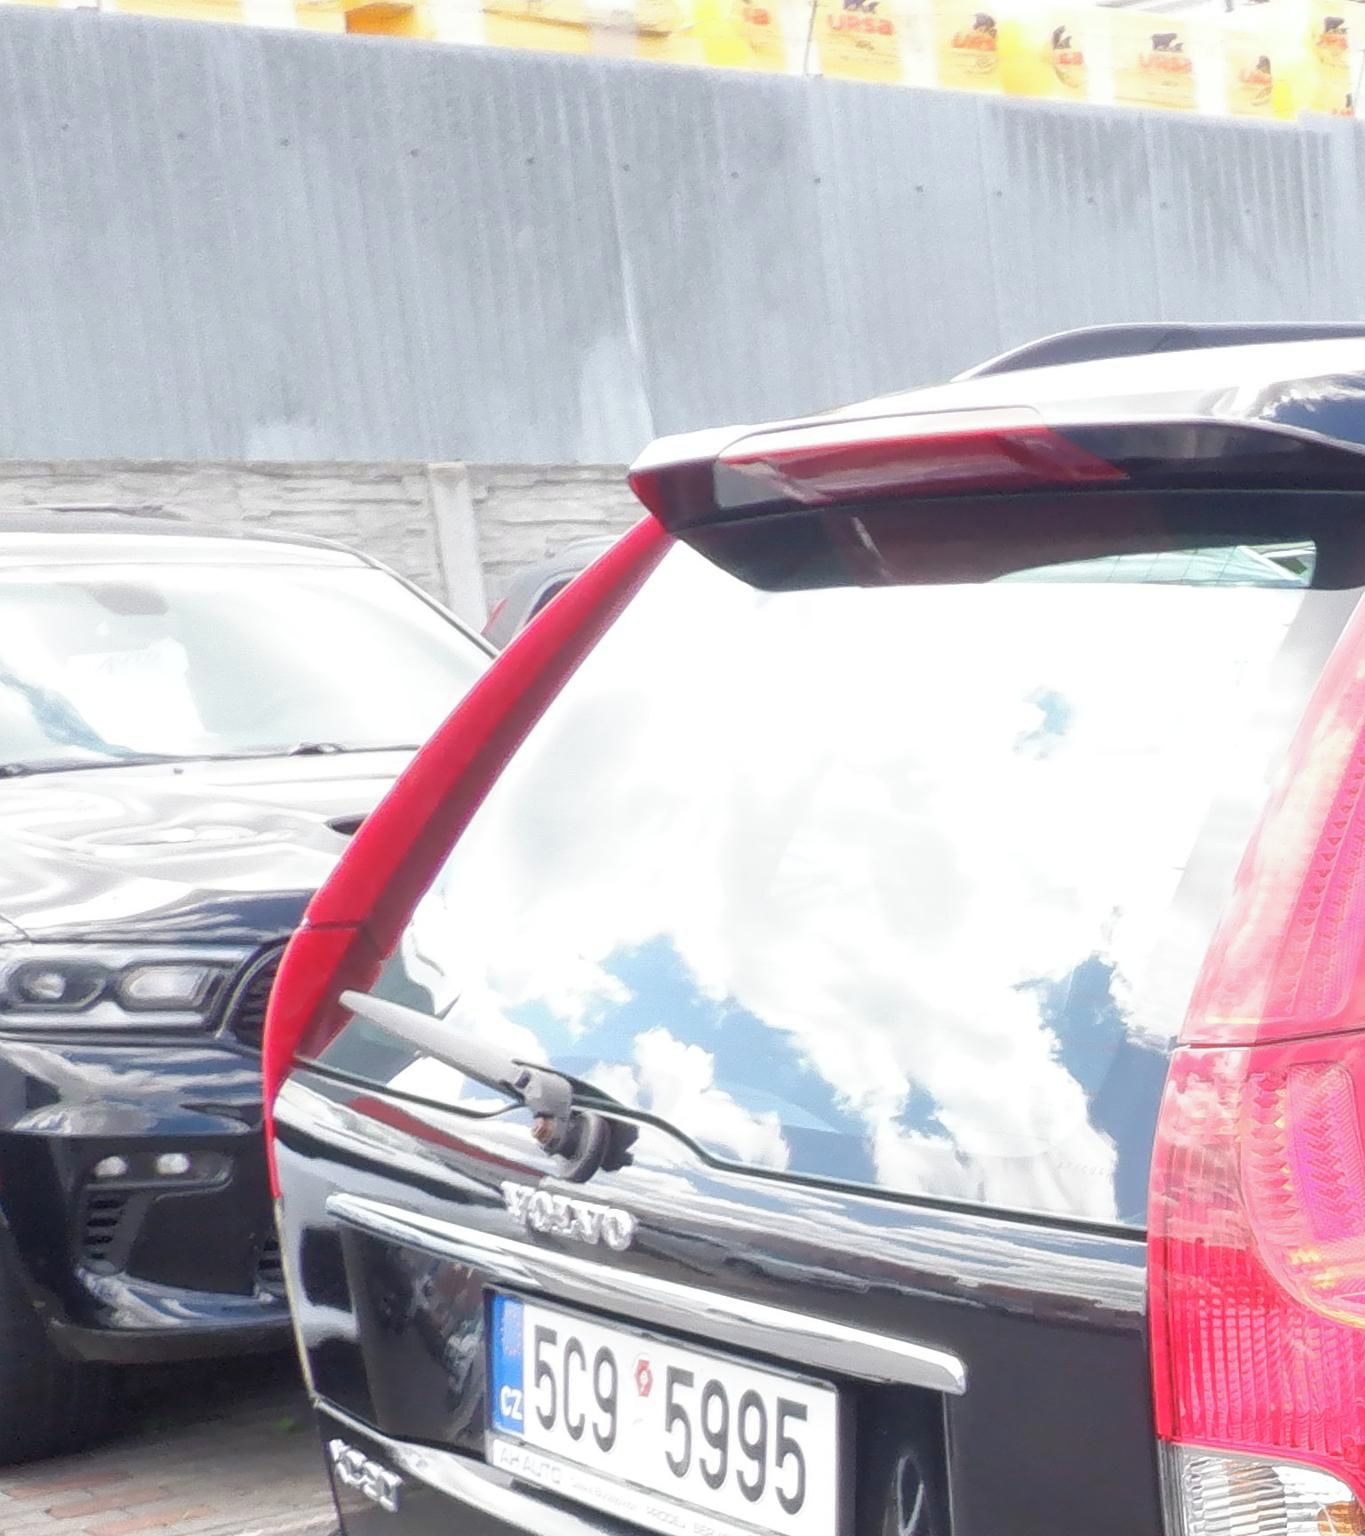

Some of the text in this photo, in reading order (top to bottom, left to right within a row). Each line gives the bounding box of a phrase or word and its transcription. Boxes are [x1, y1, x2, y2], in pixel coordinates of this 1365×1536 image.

[501, 1180, 638, 1251] VOLVO
[500, 1385, 524, 1421] CZ
[534, 1324, 809, 1515] 5C9 5995
